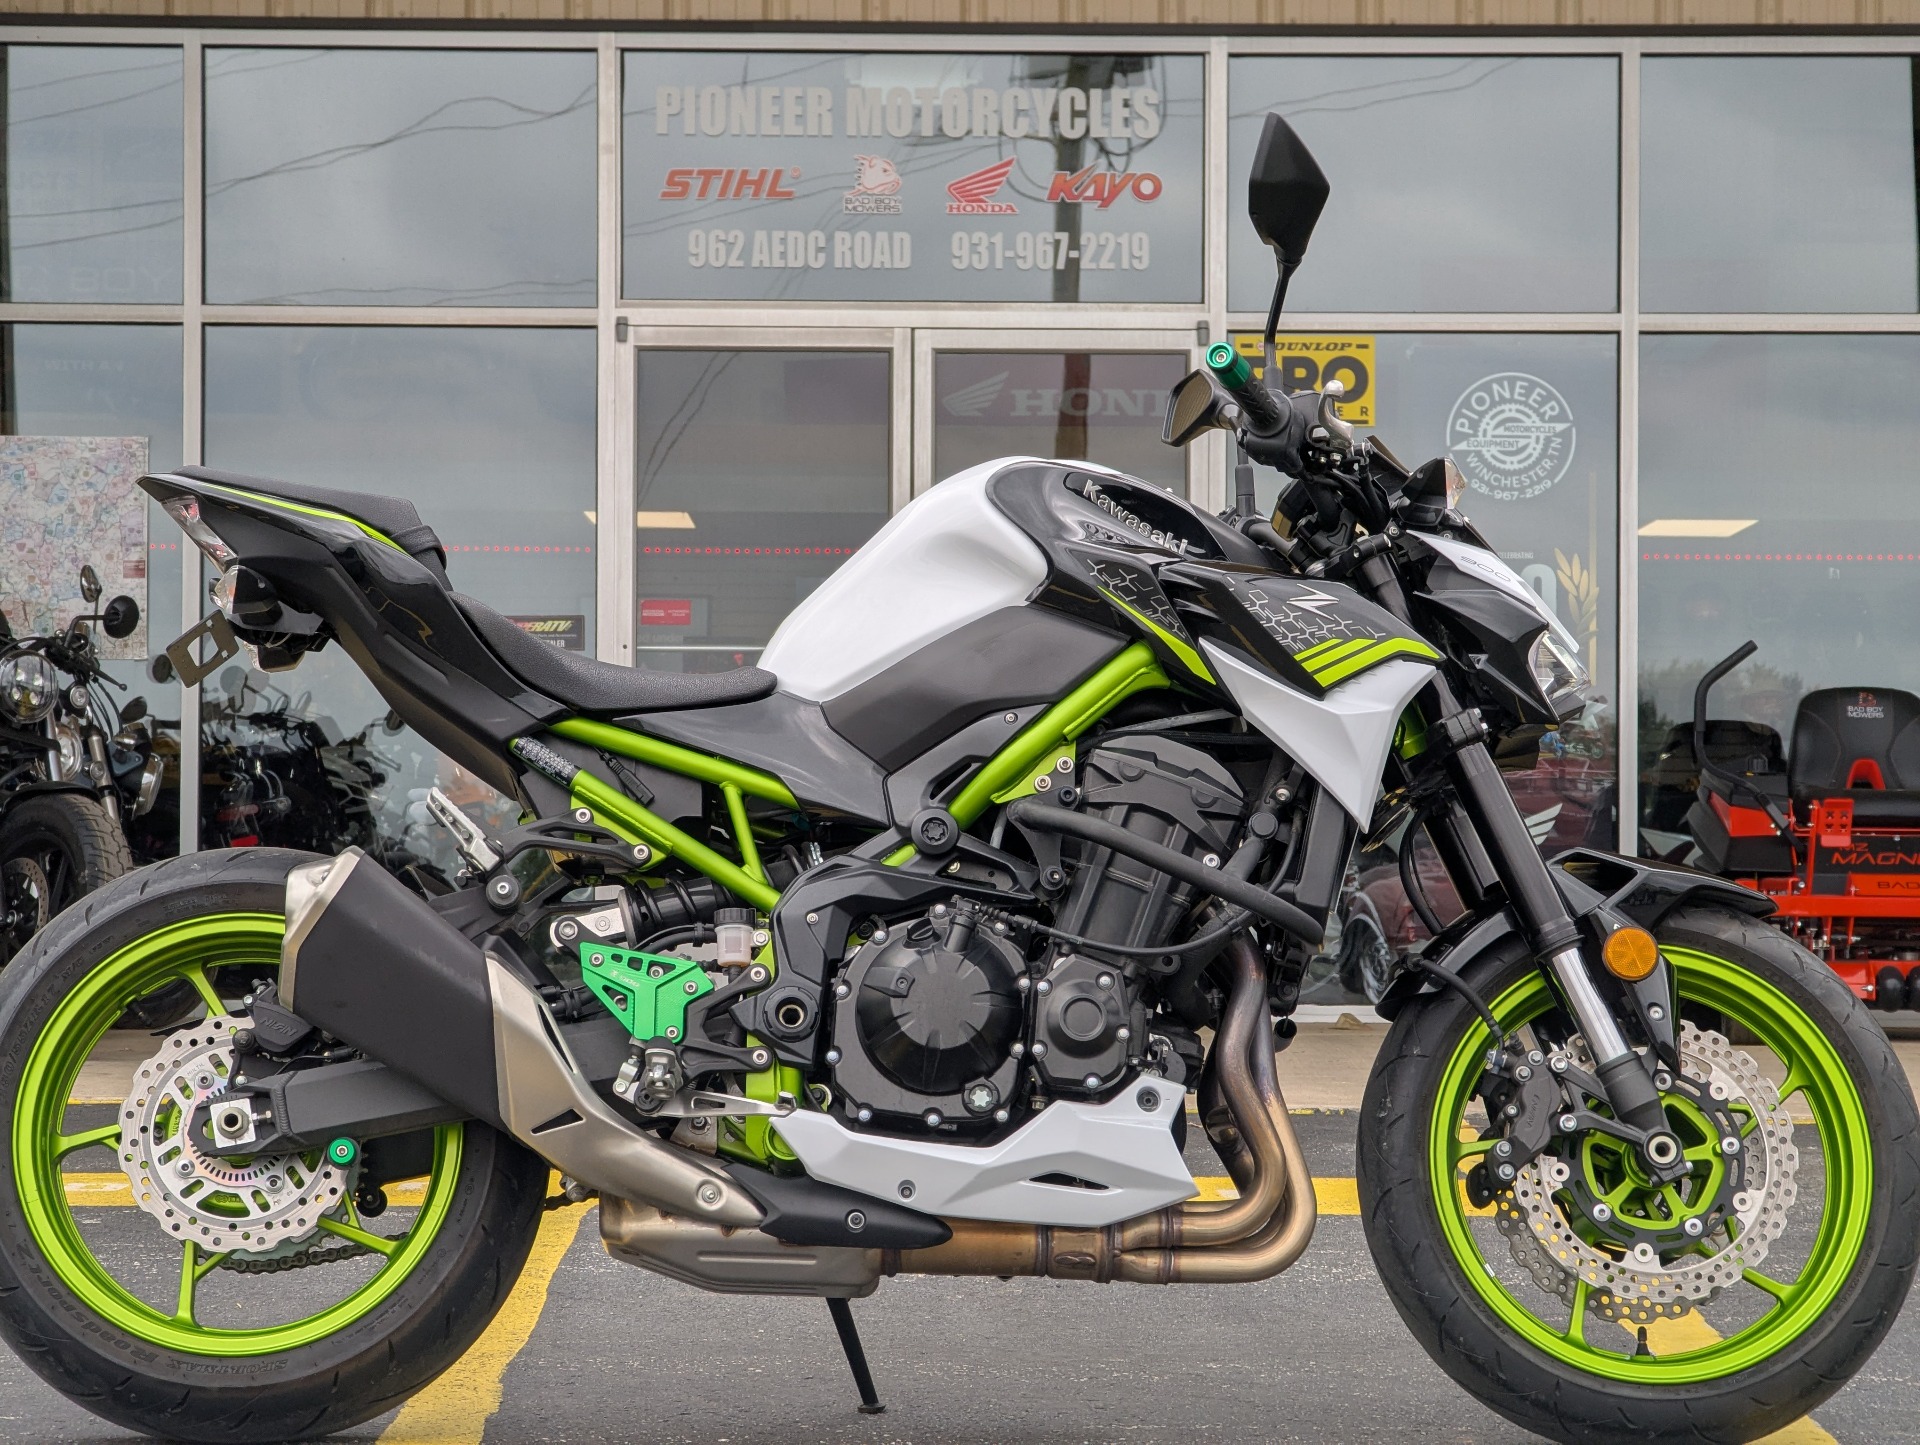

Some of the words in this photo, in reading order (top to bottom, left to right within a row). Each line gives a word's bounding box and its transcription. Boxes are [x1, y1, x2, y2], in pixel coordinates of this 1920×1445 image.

[655, 86, 833, 137] PIONEER
[846, 86, 1161, 139] MOTORCYCLES
[659, 167, 796, 200] STIHL
[1046, 160, 1164, 210] KAYO
[844, 204, 901, 213] MOWERS
[947, 203, 1018, 214] HONDA
[687, 229, 744, 268] 962
[750, 229, 827, 269] AEDC
[834, 230, 912, 269] ROAD
[950, 230, 1151, 271] 931-967-2219
[1275, 341, 1353, 352] DUNLOP
[1009, 388, 1171, 417] HON
[1455, 380, 1560, 435] PIONEER
[1503, 425, 1557, 433] MOTORCYCLES
[1466, 439, 1520, 449] EQUIPMENT
[1547, 436, 1563, 456] TN
[1470, 478, 1553, 501] 931-967-2219
[1083, 479, 1189, 556] Kawasaki
[1831, 851, 1920, 865] MAGN
[1877, 881, 1920, 889] BAD
[28, 1265, 160, 1363] Roadsport
[166, 1358, 289, 1376] SPORTMAX
